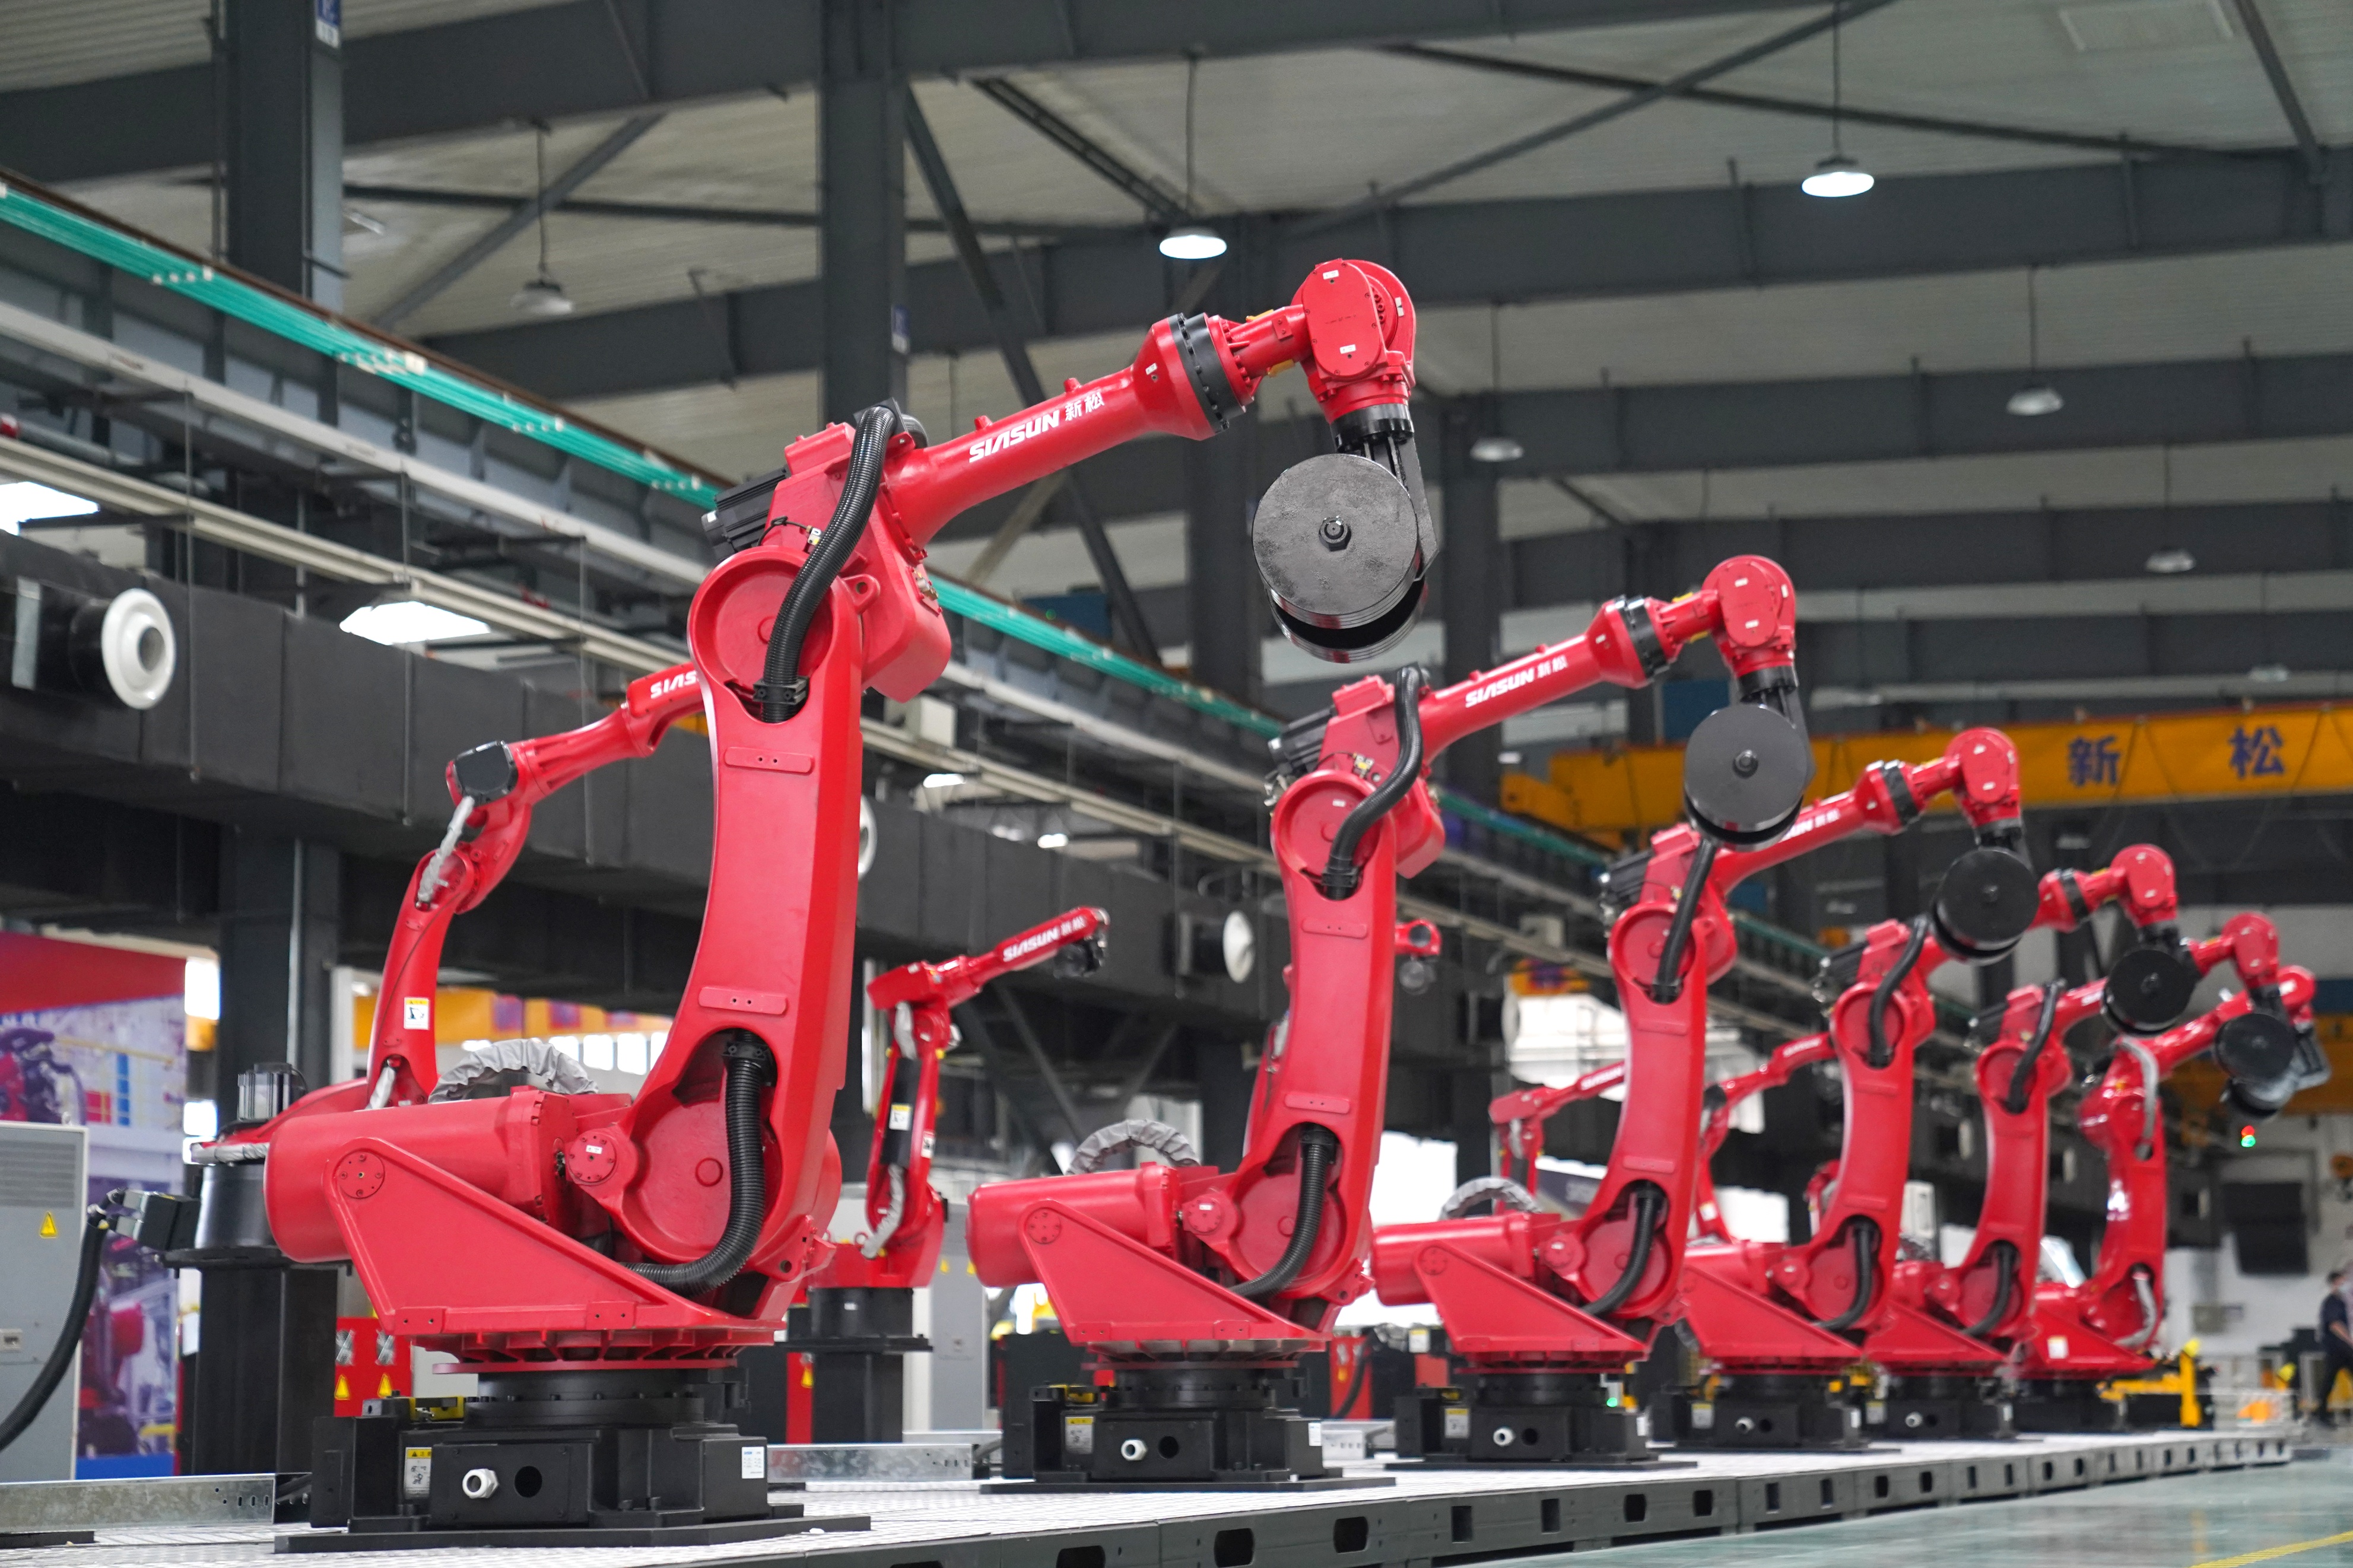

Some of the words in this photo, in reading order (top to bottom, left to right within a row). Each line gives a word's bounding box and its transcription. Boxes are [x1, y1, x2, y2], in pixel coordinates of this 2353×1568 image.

[968, 410, 1059, 463] SIASUN
[1065, 392, 1104, 421] 新松
[650, 670, 699, 699] SIAS
[1465, 667, 1535, 708] SIASUN
[2067, 726, 2285, 787] 新松
